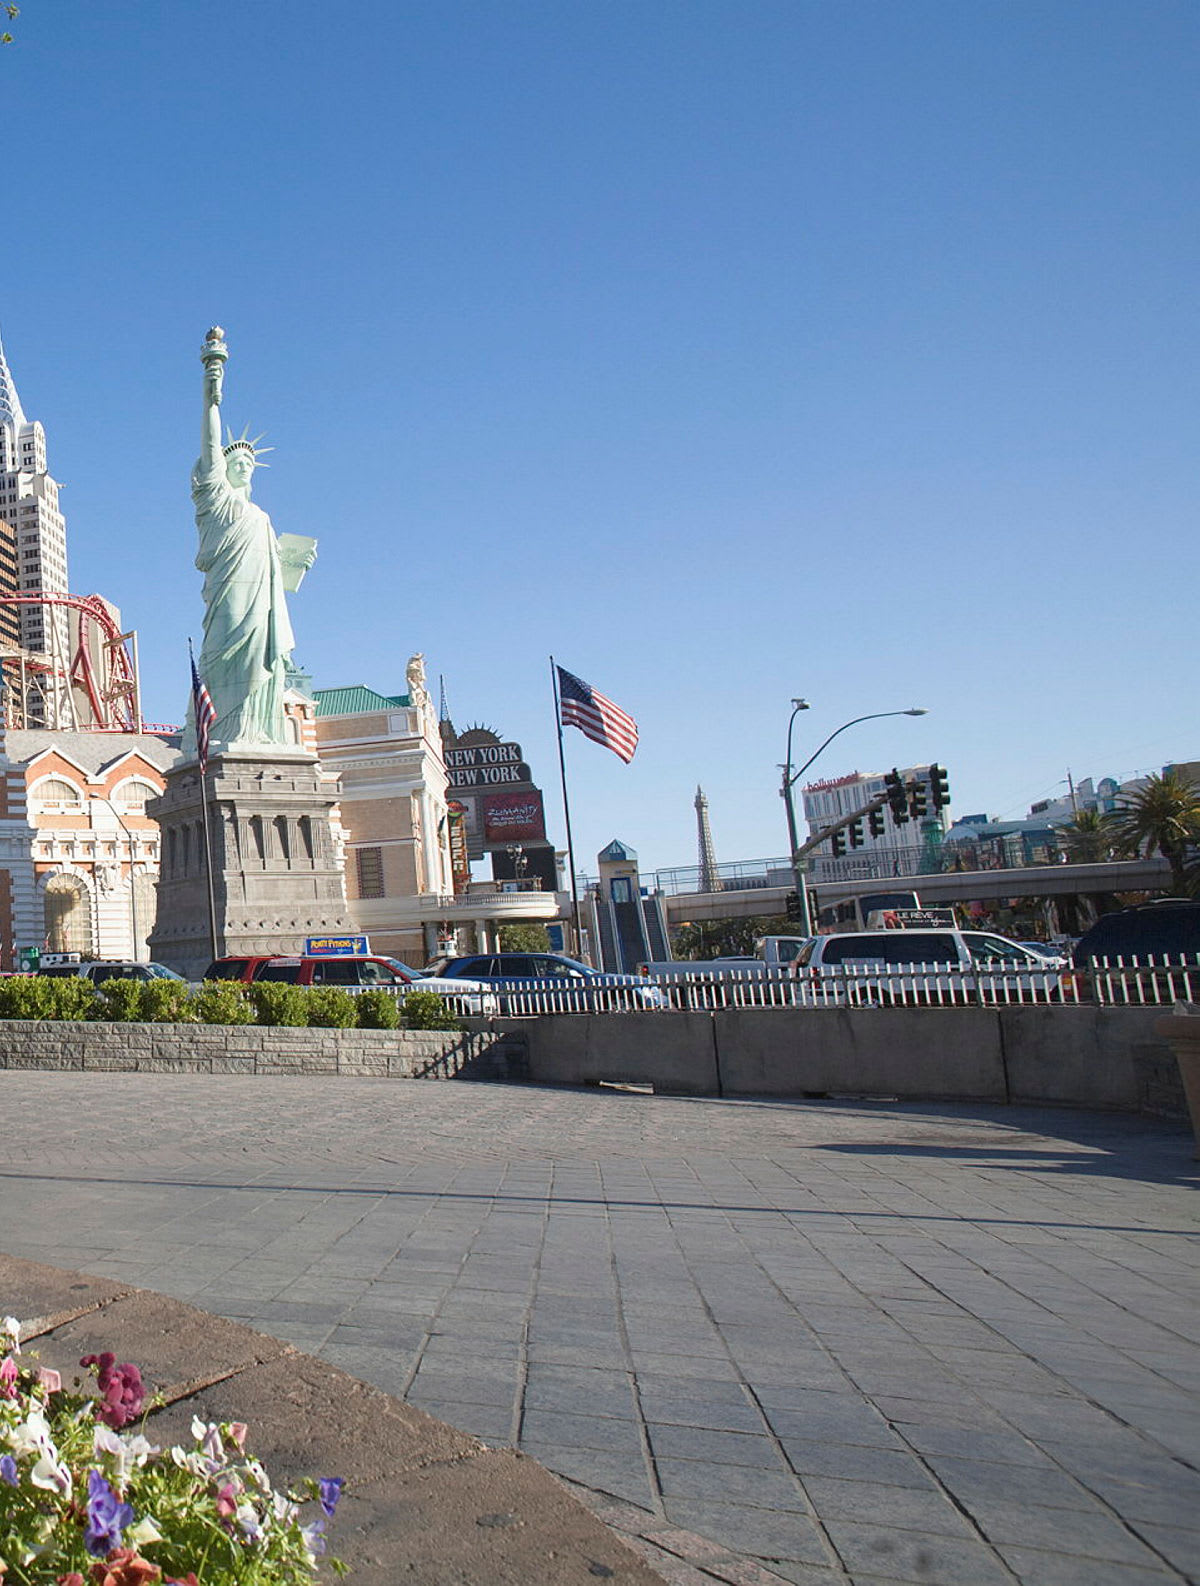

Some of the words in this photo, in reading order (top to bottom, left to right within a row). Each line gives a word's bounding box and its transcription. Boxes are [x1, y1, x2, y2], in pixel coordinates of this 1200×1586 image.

[444, 748, 477, 767] NEW
[480, 745, 520, 763] YORK
[446, 769, 478, 787] NEW
[481, 765, 521, 783] YORK
